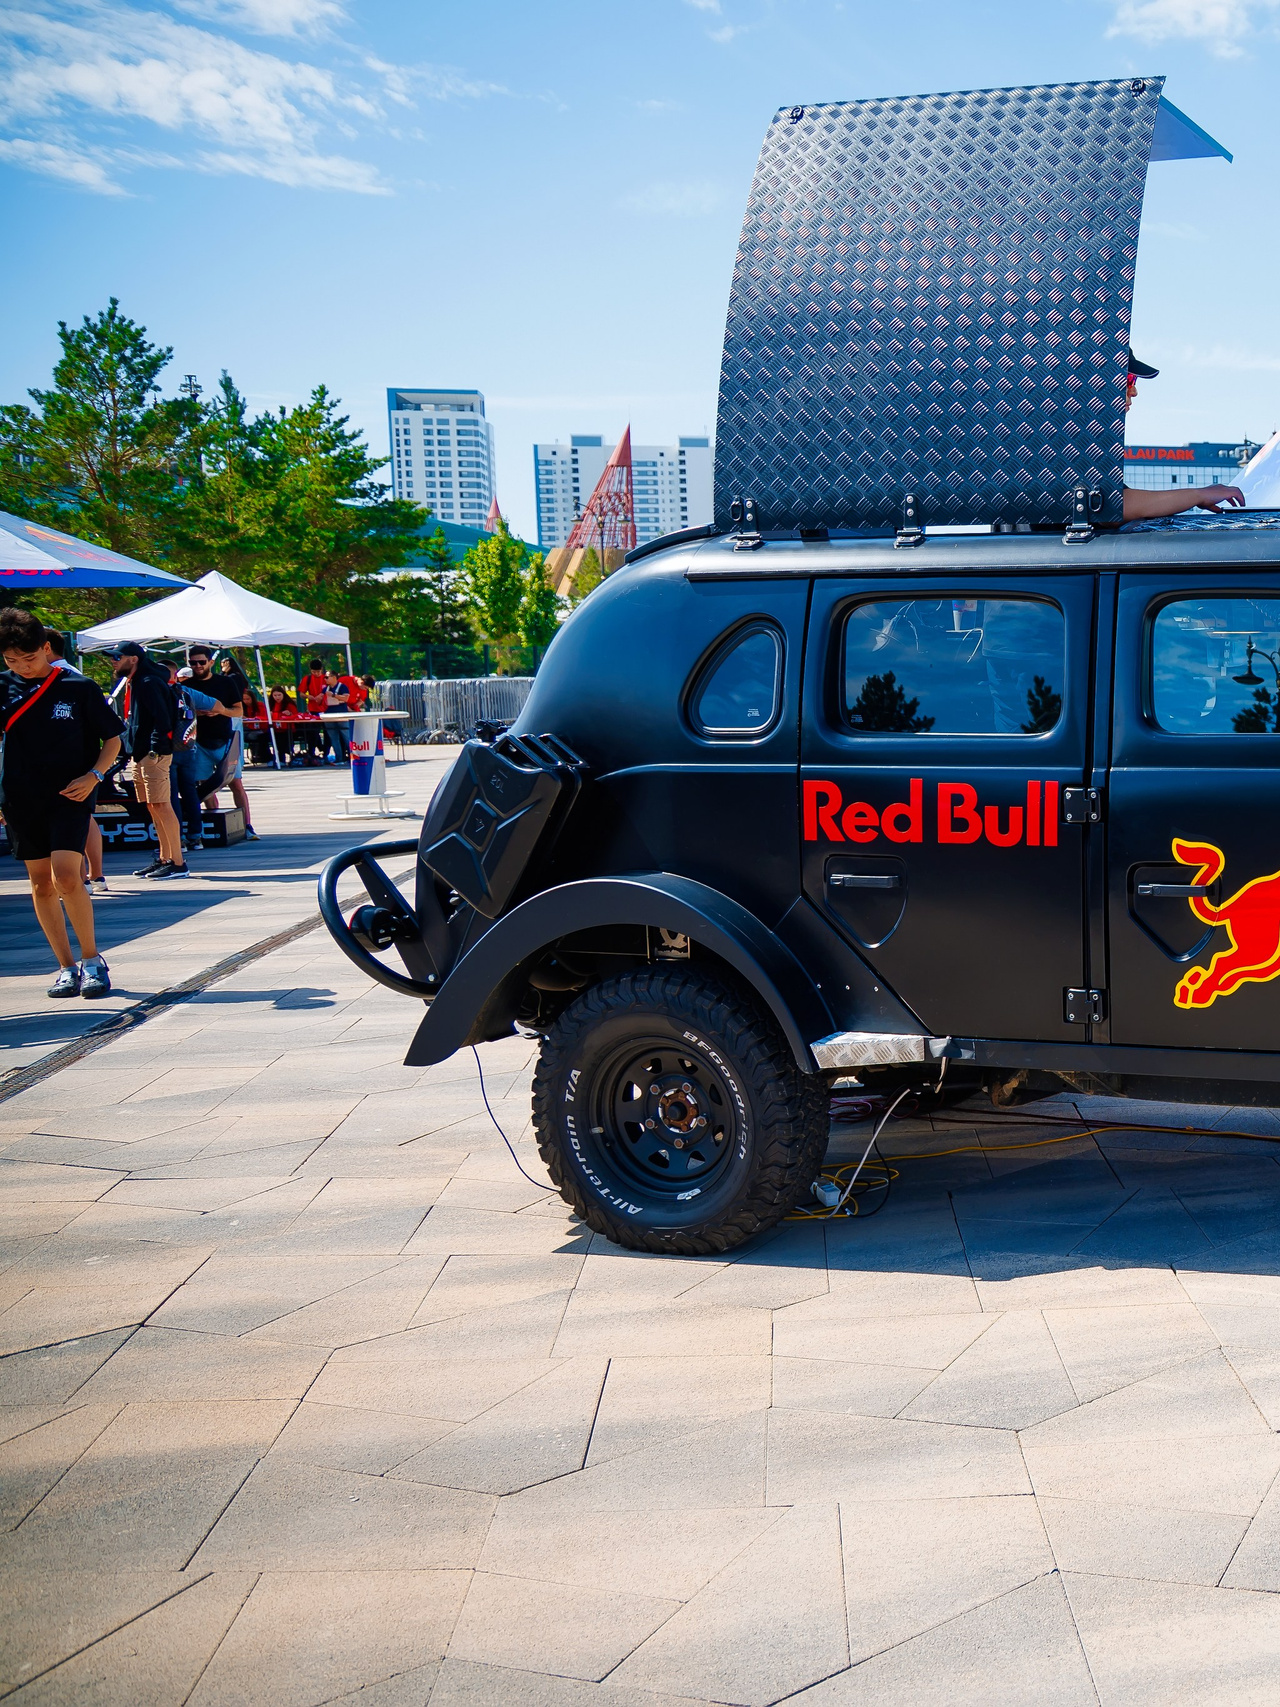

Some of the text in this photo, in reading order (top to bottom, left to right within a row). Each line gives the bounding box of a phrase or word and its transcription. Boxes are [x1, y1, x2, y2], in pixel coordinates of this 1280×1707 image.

[1157, 448, 1195, 461] PARK
[55, 709, 71, 718] CON
[803, 778, 1059, 847] Red Bull
[682, 1030, 746, 1160] BFGoodrich
[564, 1068, 644, 1215] All-Terrain T/A
